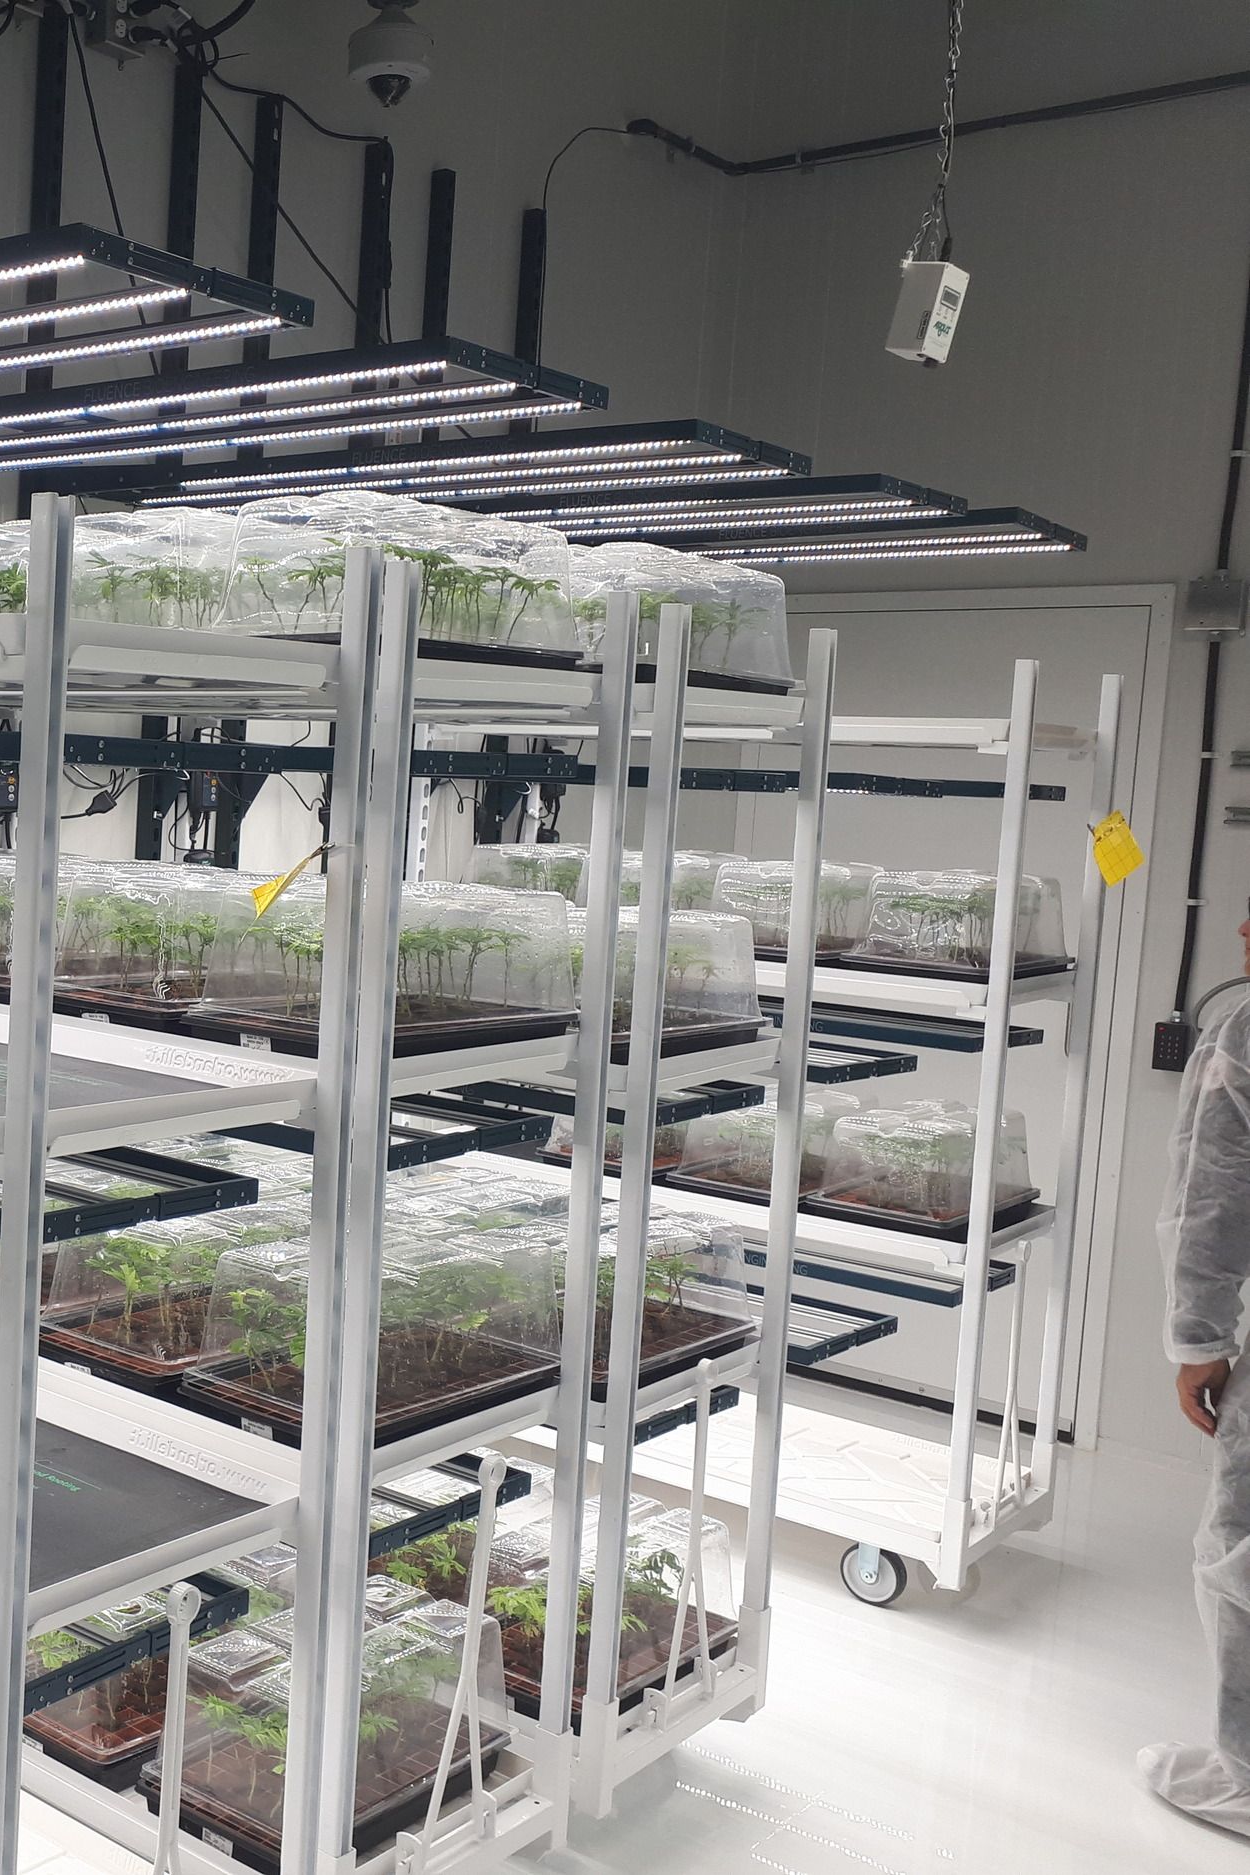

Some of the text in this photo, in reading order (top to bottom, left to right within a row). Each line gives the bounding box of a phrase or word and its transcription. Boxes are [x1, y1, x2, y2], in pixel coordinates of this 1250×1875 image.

[84, 381, 141, 403] FLUENCE
[352, 447, 406, 464] FLUENCE
[559, 493, 611, 508] FLUENCE
[718, 526, 767, 541] FLUENCE
